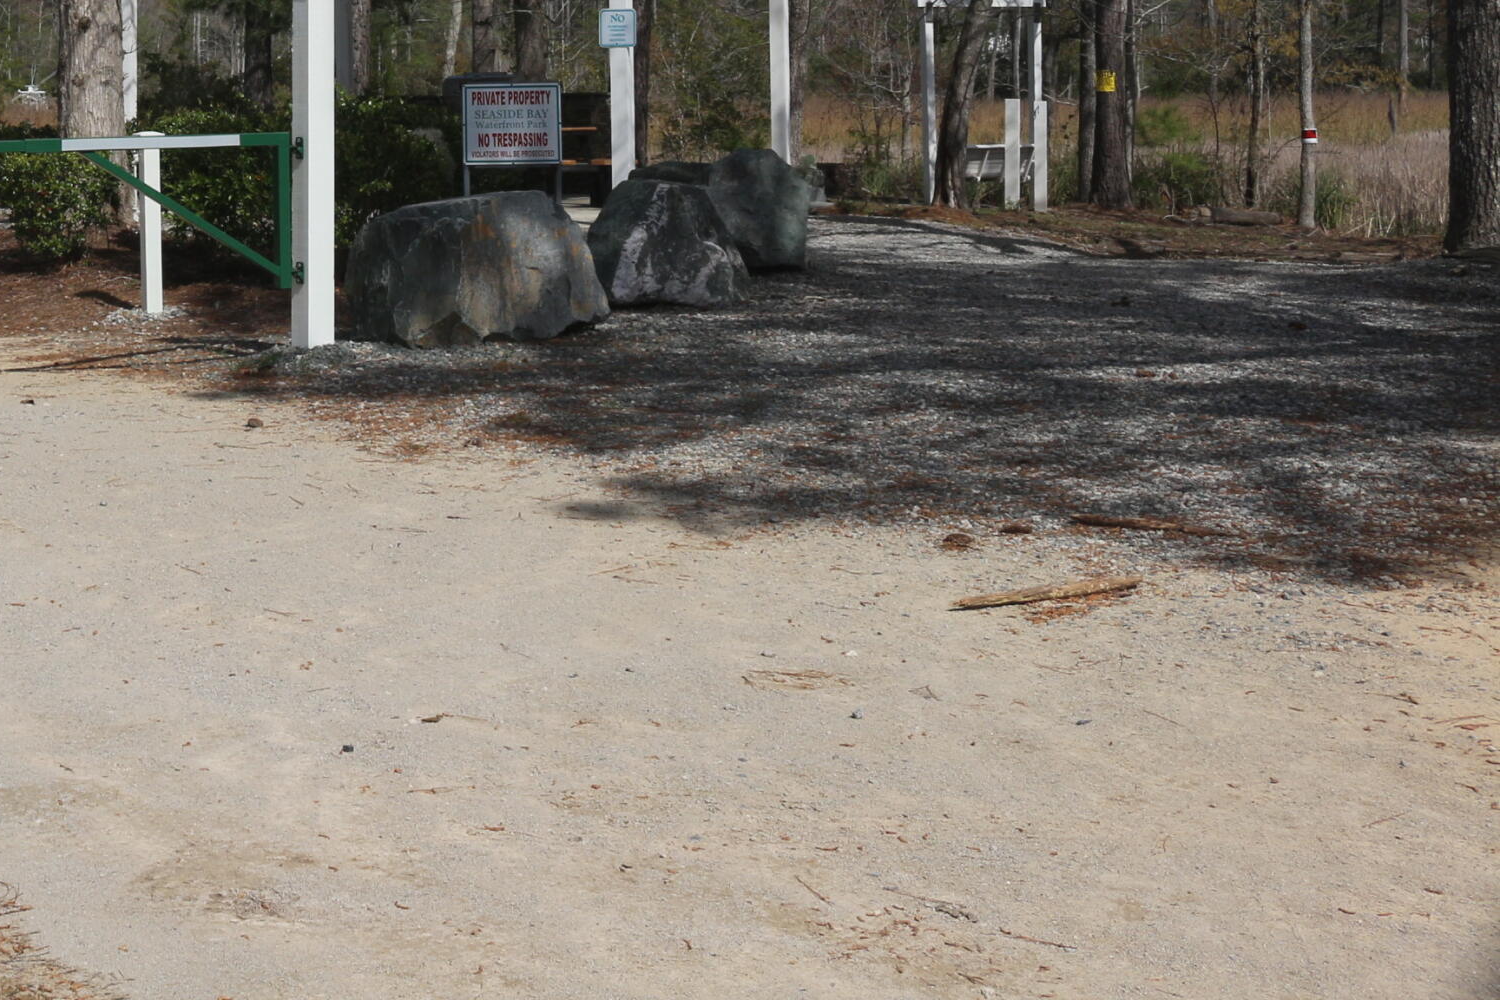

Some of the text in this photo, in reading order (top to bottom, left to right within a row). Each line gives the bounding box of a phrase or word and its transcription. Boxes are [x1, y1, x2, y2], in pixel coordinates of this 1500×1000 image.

[610, 15, 625, 23] NO
[471, 90, 551, 106] PRIVATE PROPERTY
[474, 108, 549, 119] SEASIDE BAY
[475, 119, 548, 129] Waterfront Park
[478, 133, 548, 147] NO TRESPASSING
[500, 150, 512, 158] WILL
[513, 150, 520, 158] BE
